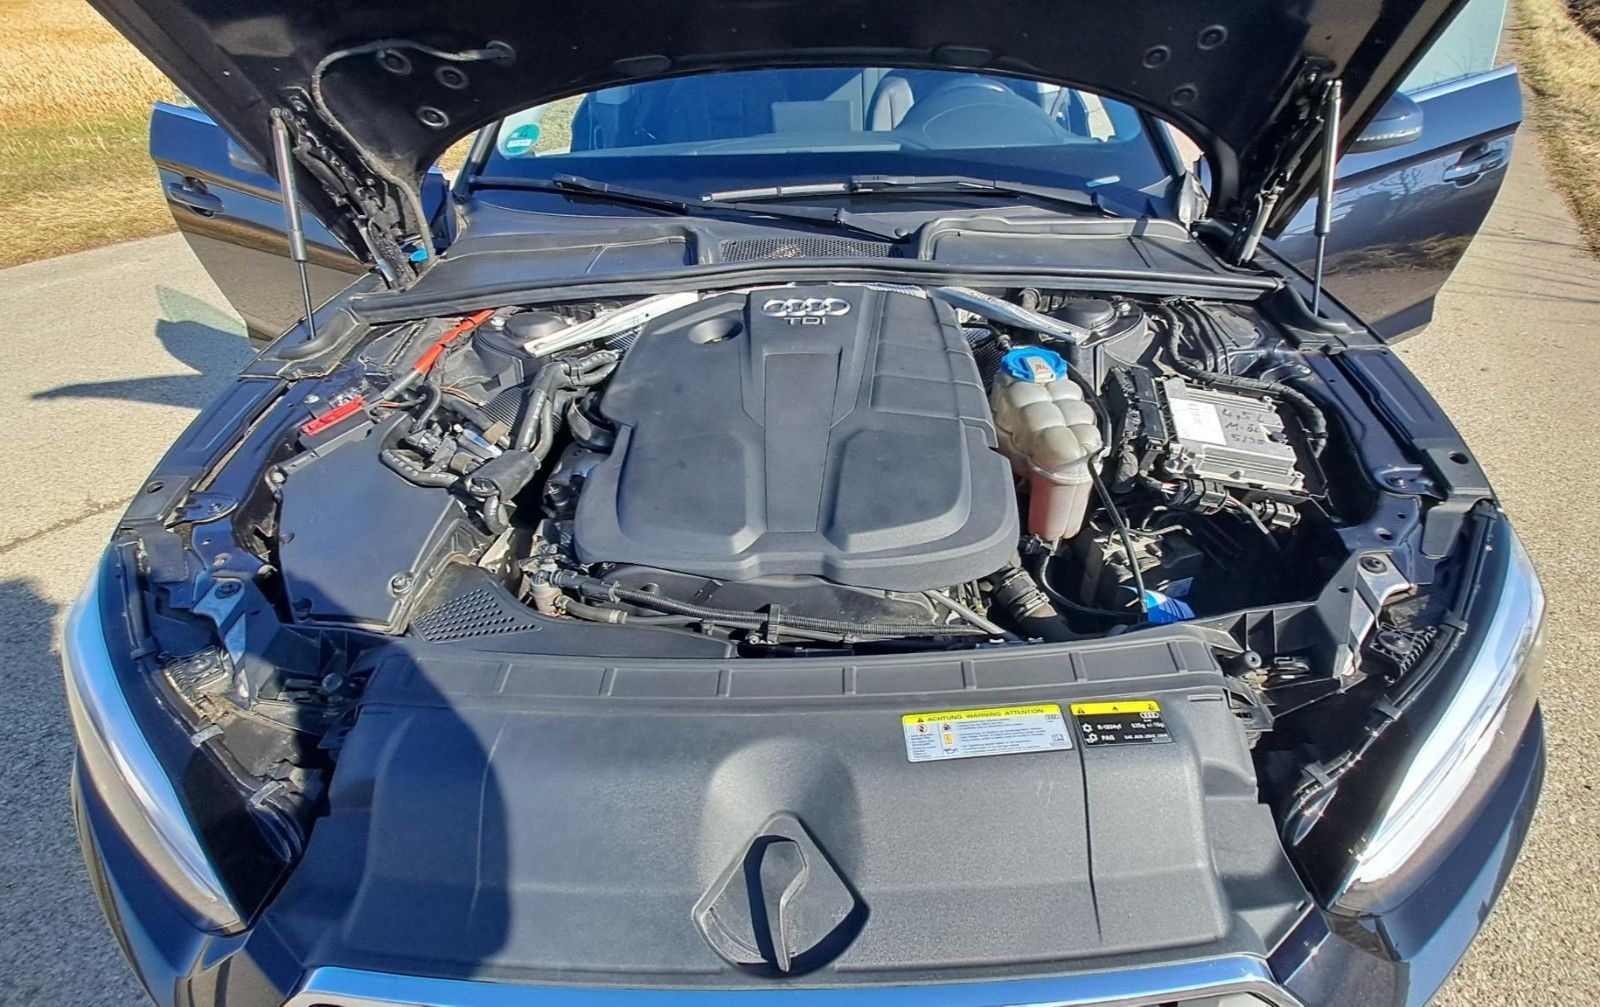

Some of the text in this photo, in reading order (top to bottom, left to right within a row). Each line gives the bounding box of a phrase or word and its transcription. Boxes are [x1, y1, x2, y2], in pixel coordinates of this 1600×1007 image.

[783, 317, 826, 325] TDI
[927, 708, 1044, 722] ACHTUNG WARNING ATTENTION
